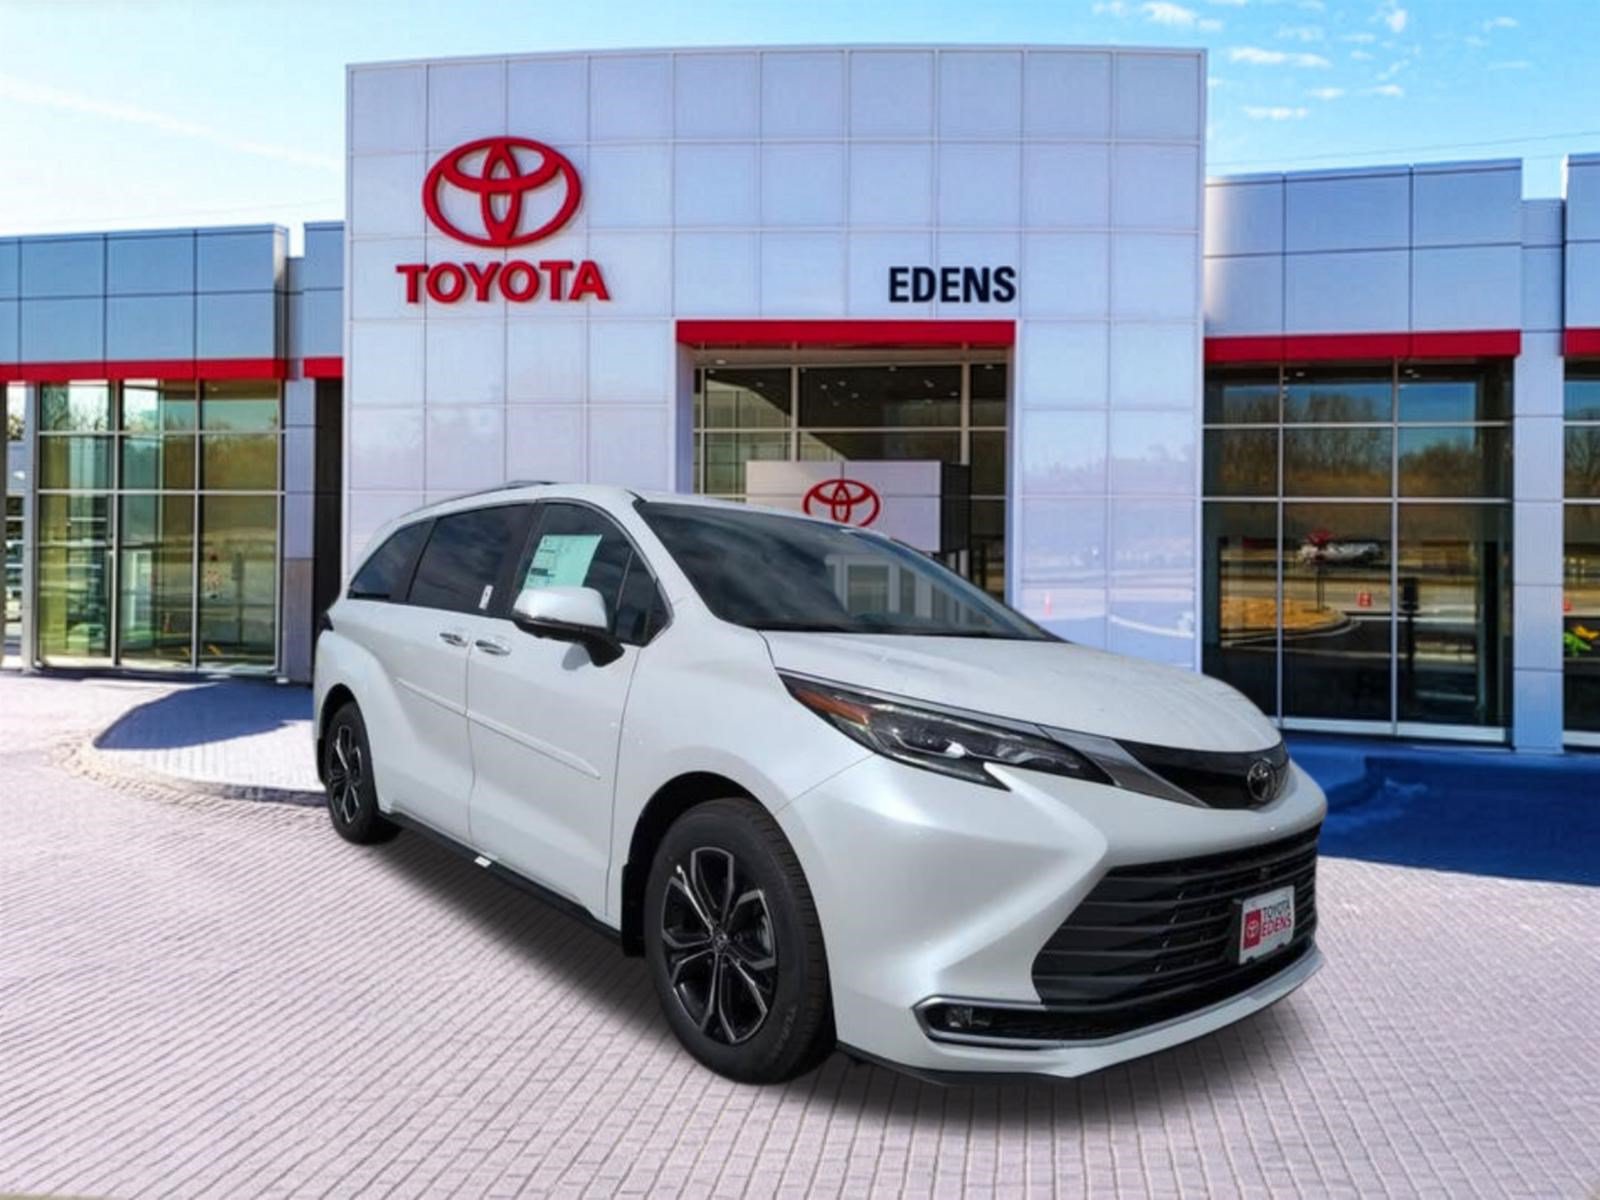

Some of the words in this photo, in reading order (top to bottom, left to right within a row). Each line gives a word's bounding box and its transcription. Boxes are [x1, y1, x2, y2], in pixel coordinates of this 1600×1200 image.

[396, 260, 610, 304] TOYOTA
[889, 266, 1016, 303] EDENS
[1262, 916, 1292, 937] EDENS
